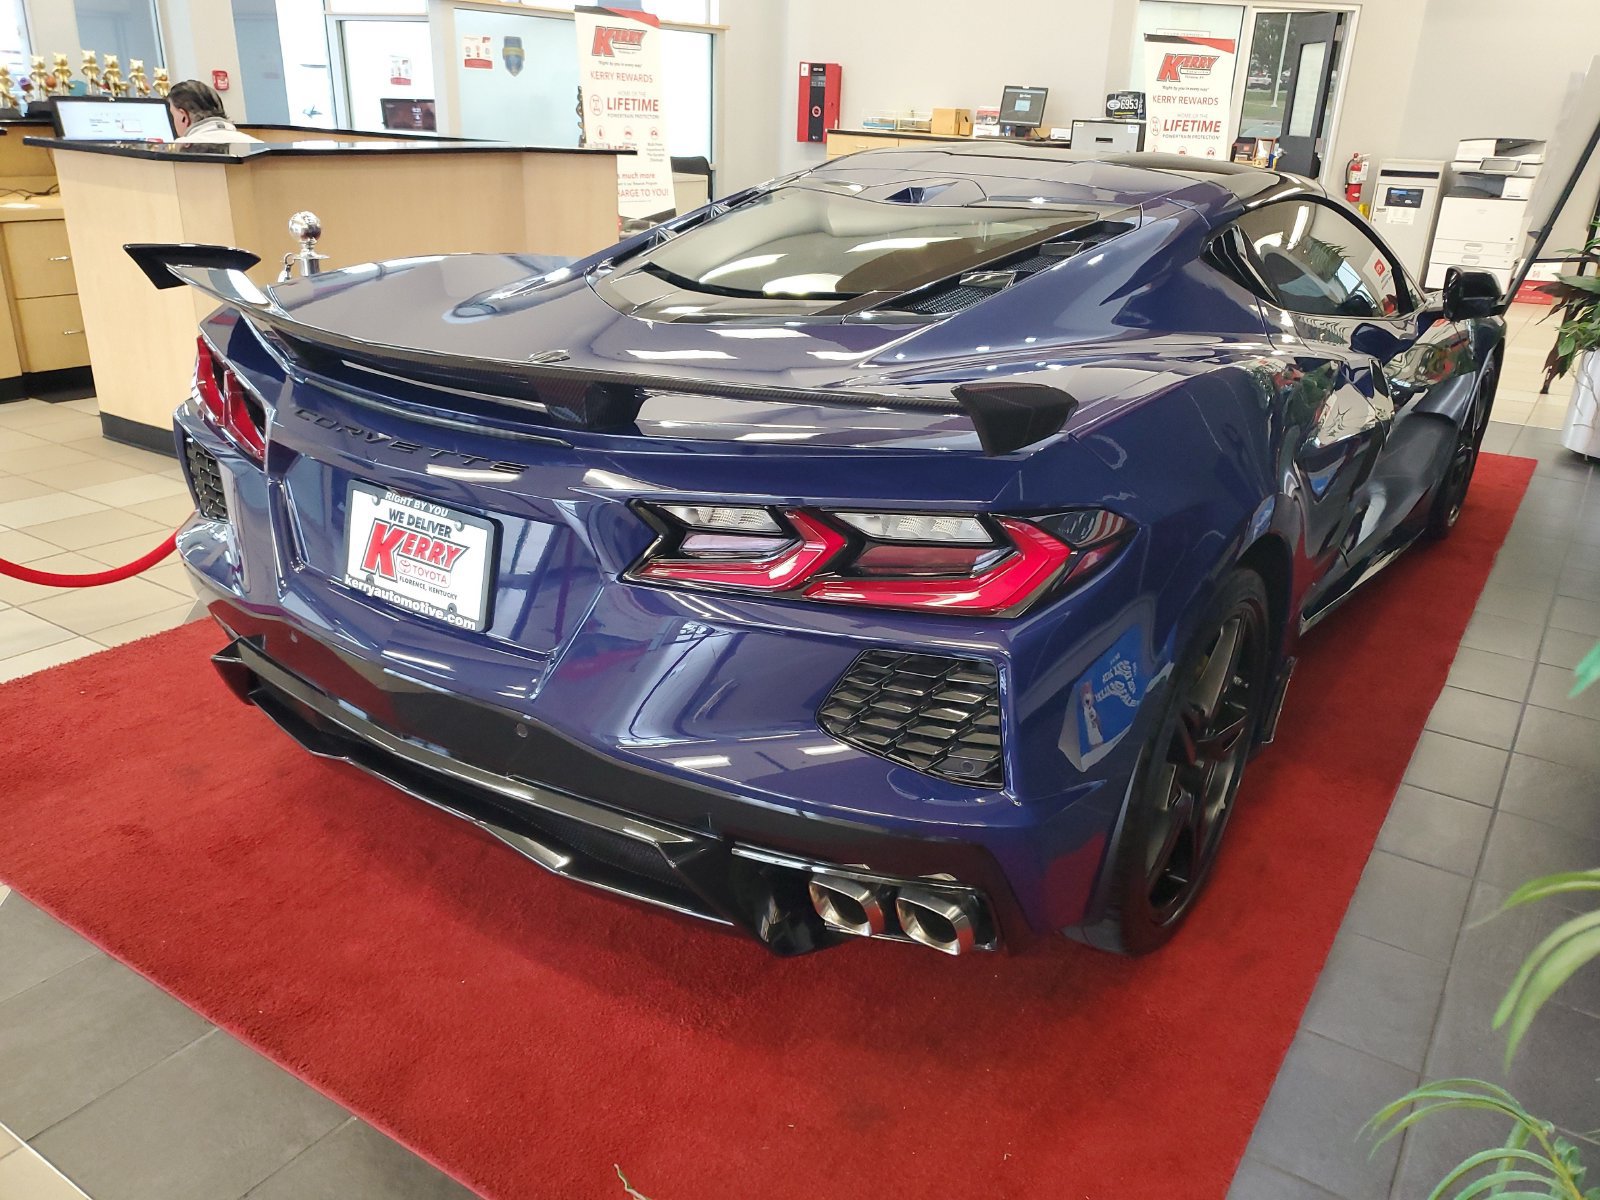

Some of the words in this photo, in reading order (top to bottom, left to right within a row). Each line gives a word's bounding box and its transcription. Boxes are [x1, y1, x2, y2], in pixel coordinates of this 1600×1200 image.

[590, 71, 614, 80] KERRY
[616, 72, 653, 83] REWARDS
[1156, 53, 1220, 82] KERRY
[607, 97, 659, 112] LIFETIME
[1120, 98, 1139, 110] 6953
[1152, 95, 1177, 104] KERRY
[1178, 96, 1219, 106] REWARDS
[1163, 119, 1221, 133] LIFETIME
[640, 189, 650, 197] TO
[652, 188, 669, 196] YOU!
[294, 409, 529, 474] CORVETTE
[385, 491, 413, 505] RIGHT
[413, 500, 428, 510] BY
[428, 503, 449, 517] YOU
[389, 508, 406, 523] WE
[406, 514, 453, 538] DELIVER
[361, 519, 466, 581] KERRY
[413, 565, 447, 584] TOYOTA
[399, 575, 428, 591] FLORENCE,
[428, 586, 457, 601] KENTUCKY
[344, 574, 476, 631] kerryautomotive.com
